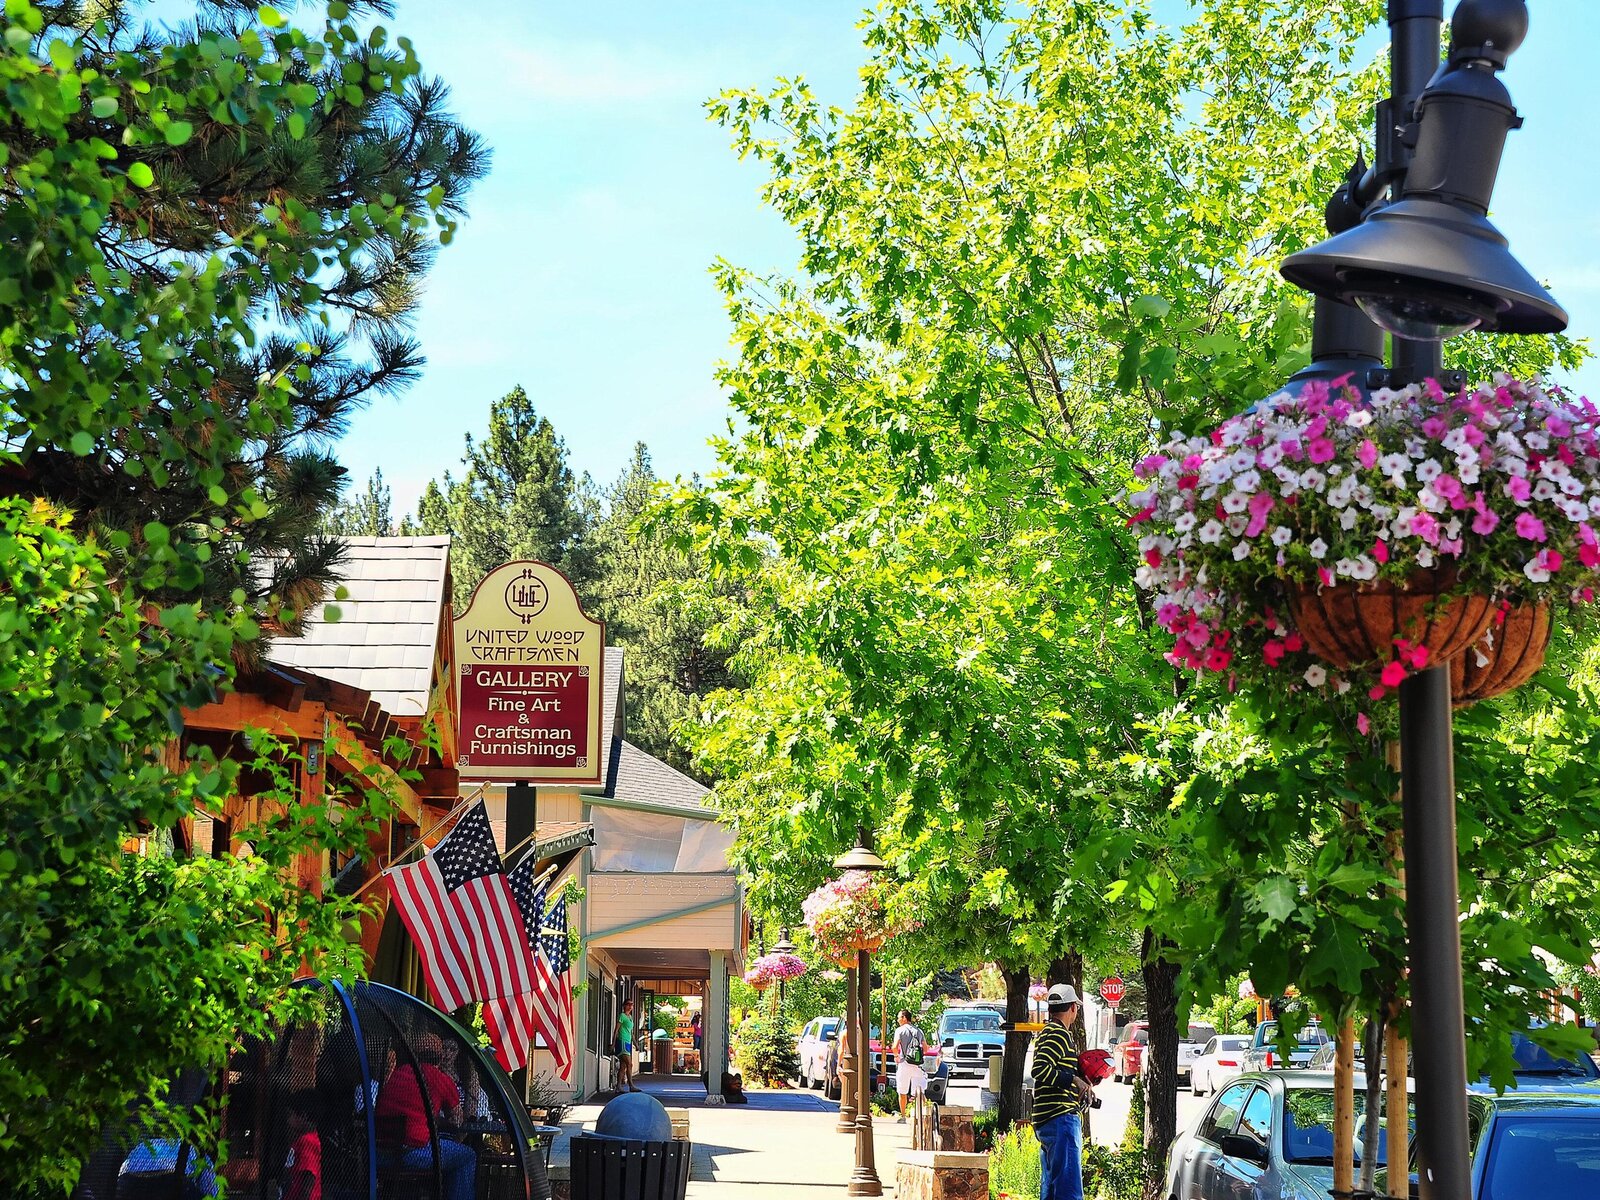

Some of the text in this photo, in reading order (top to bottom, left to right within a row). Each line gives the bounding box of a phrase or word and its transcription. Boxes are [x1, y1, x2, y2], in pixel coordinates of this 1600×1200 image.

[466, 629, 585, 645] UNITED WOOD
[471, 646, 580, 662] CRAFTSMEN
[476, 670, 573, 688] GALLERY
[488, 697, 561, 712] Fine Art
[518, 713, 530, 724] &
[474, 724, 571, 740] Craftsman
[470, 740, 577, 758] Furnishings
[1102, 984, 1124, 994] STOP
